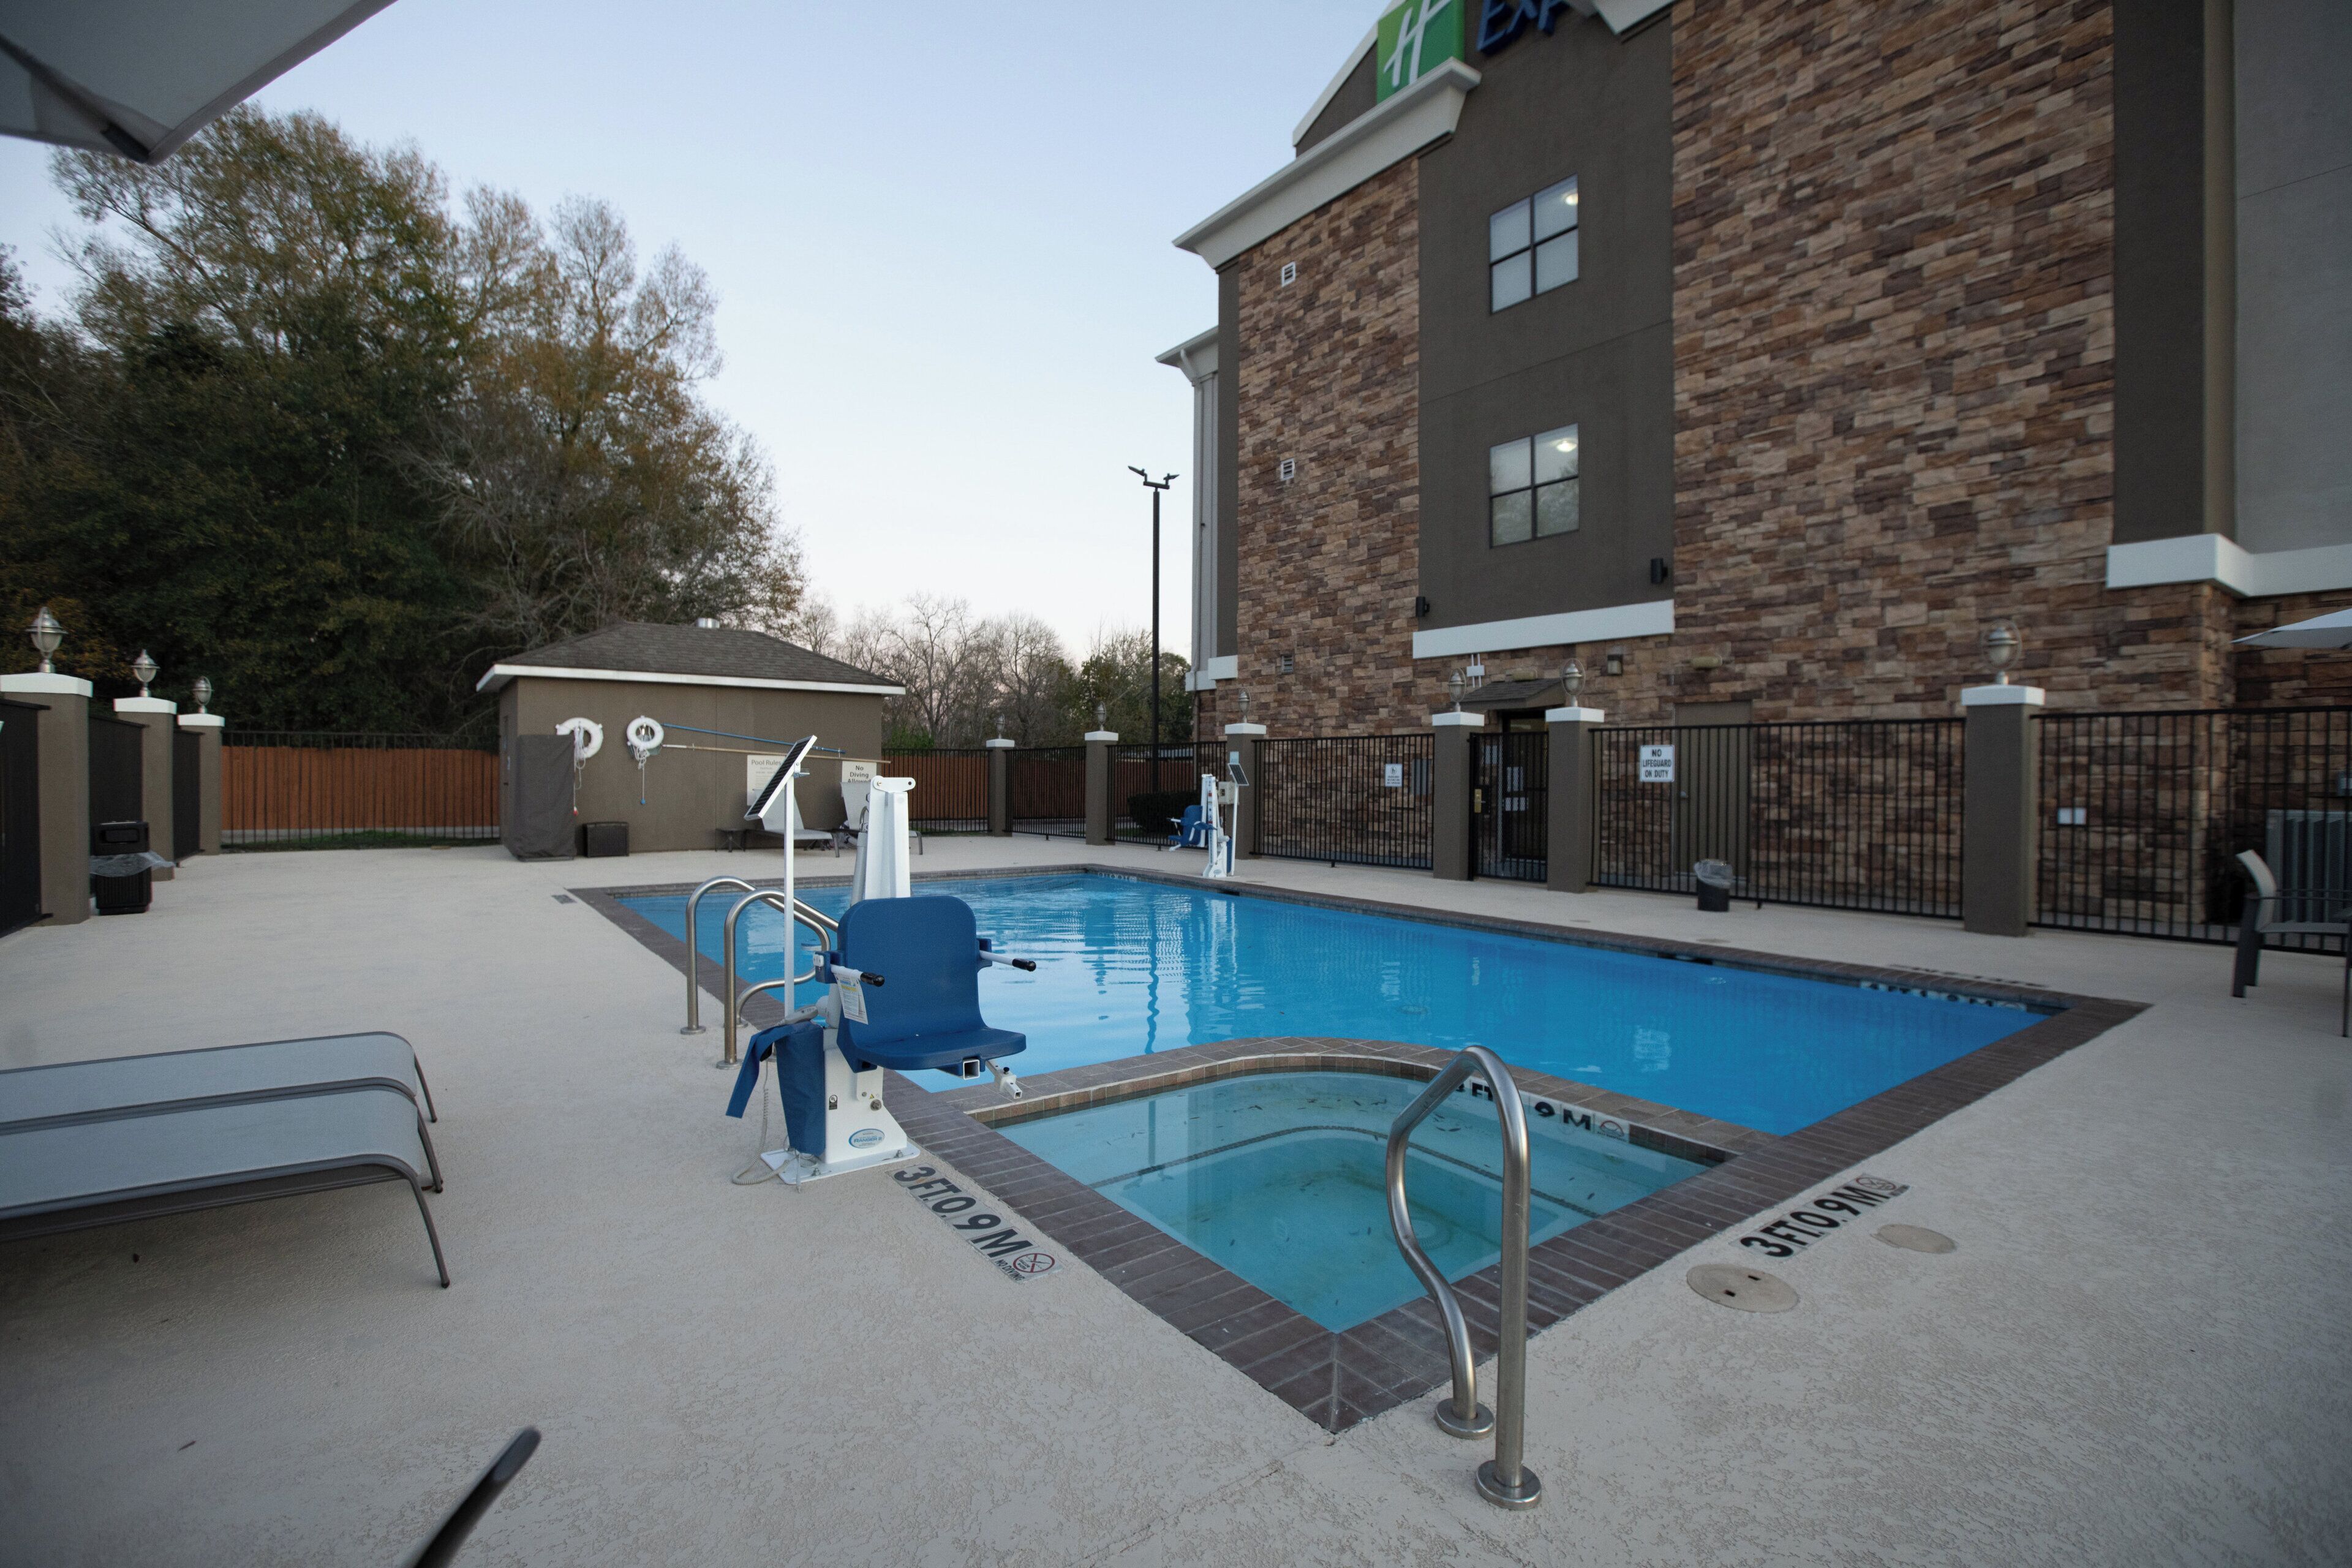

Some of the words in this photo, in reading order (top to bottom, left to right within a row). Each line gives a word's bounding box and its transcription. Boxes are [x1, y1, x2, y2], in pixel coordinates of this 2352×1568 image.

[1652, 748, 1662, 757] NO
[1643, 759, 1672, 767] LIFEGUARD
[1001, 1265, 1025, 1281] DIVING
